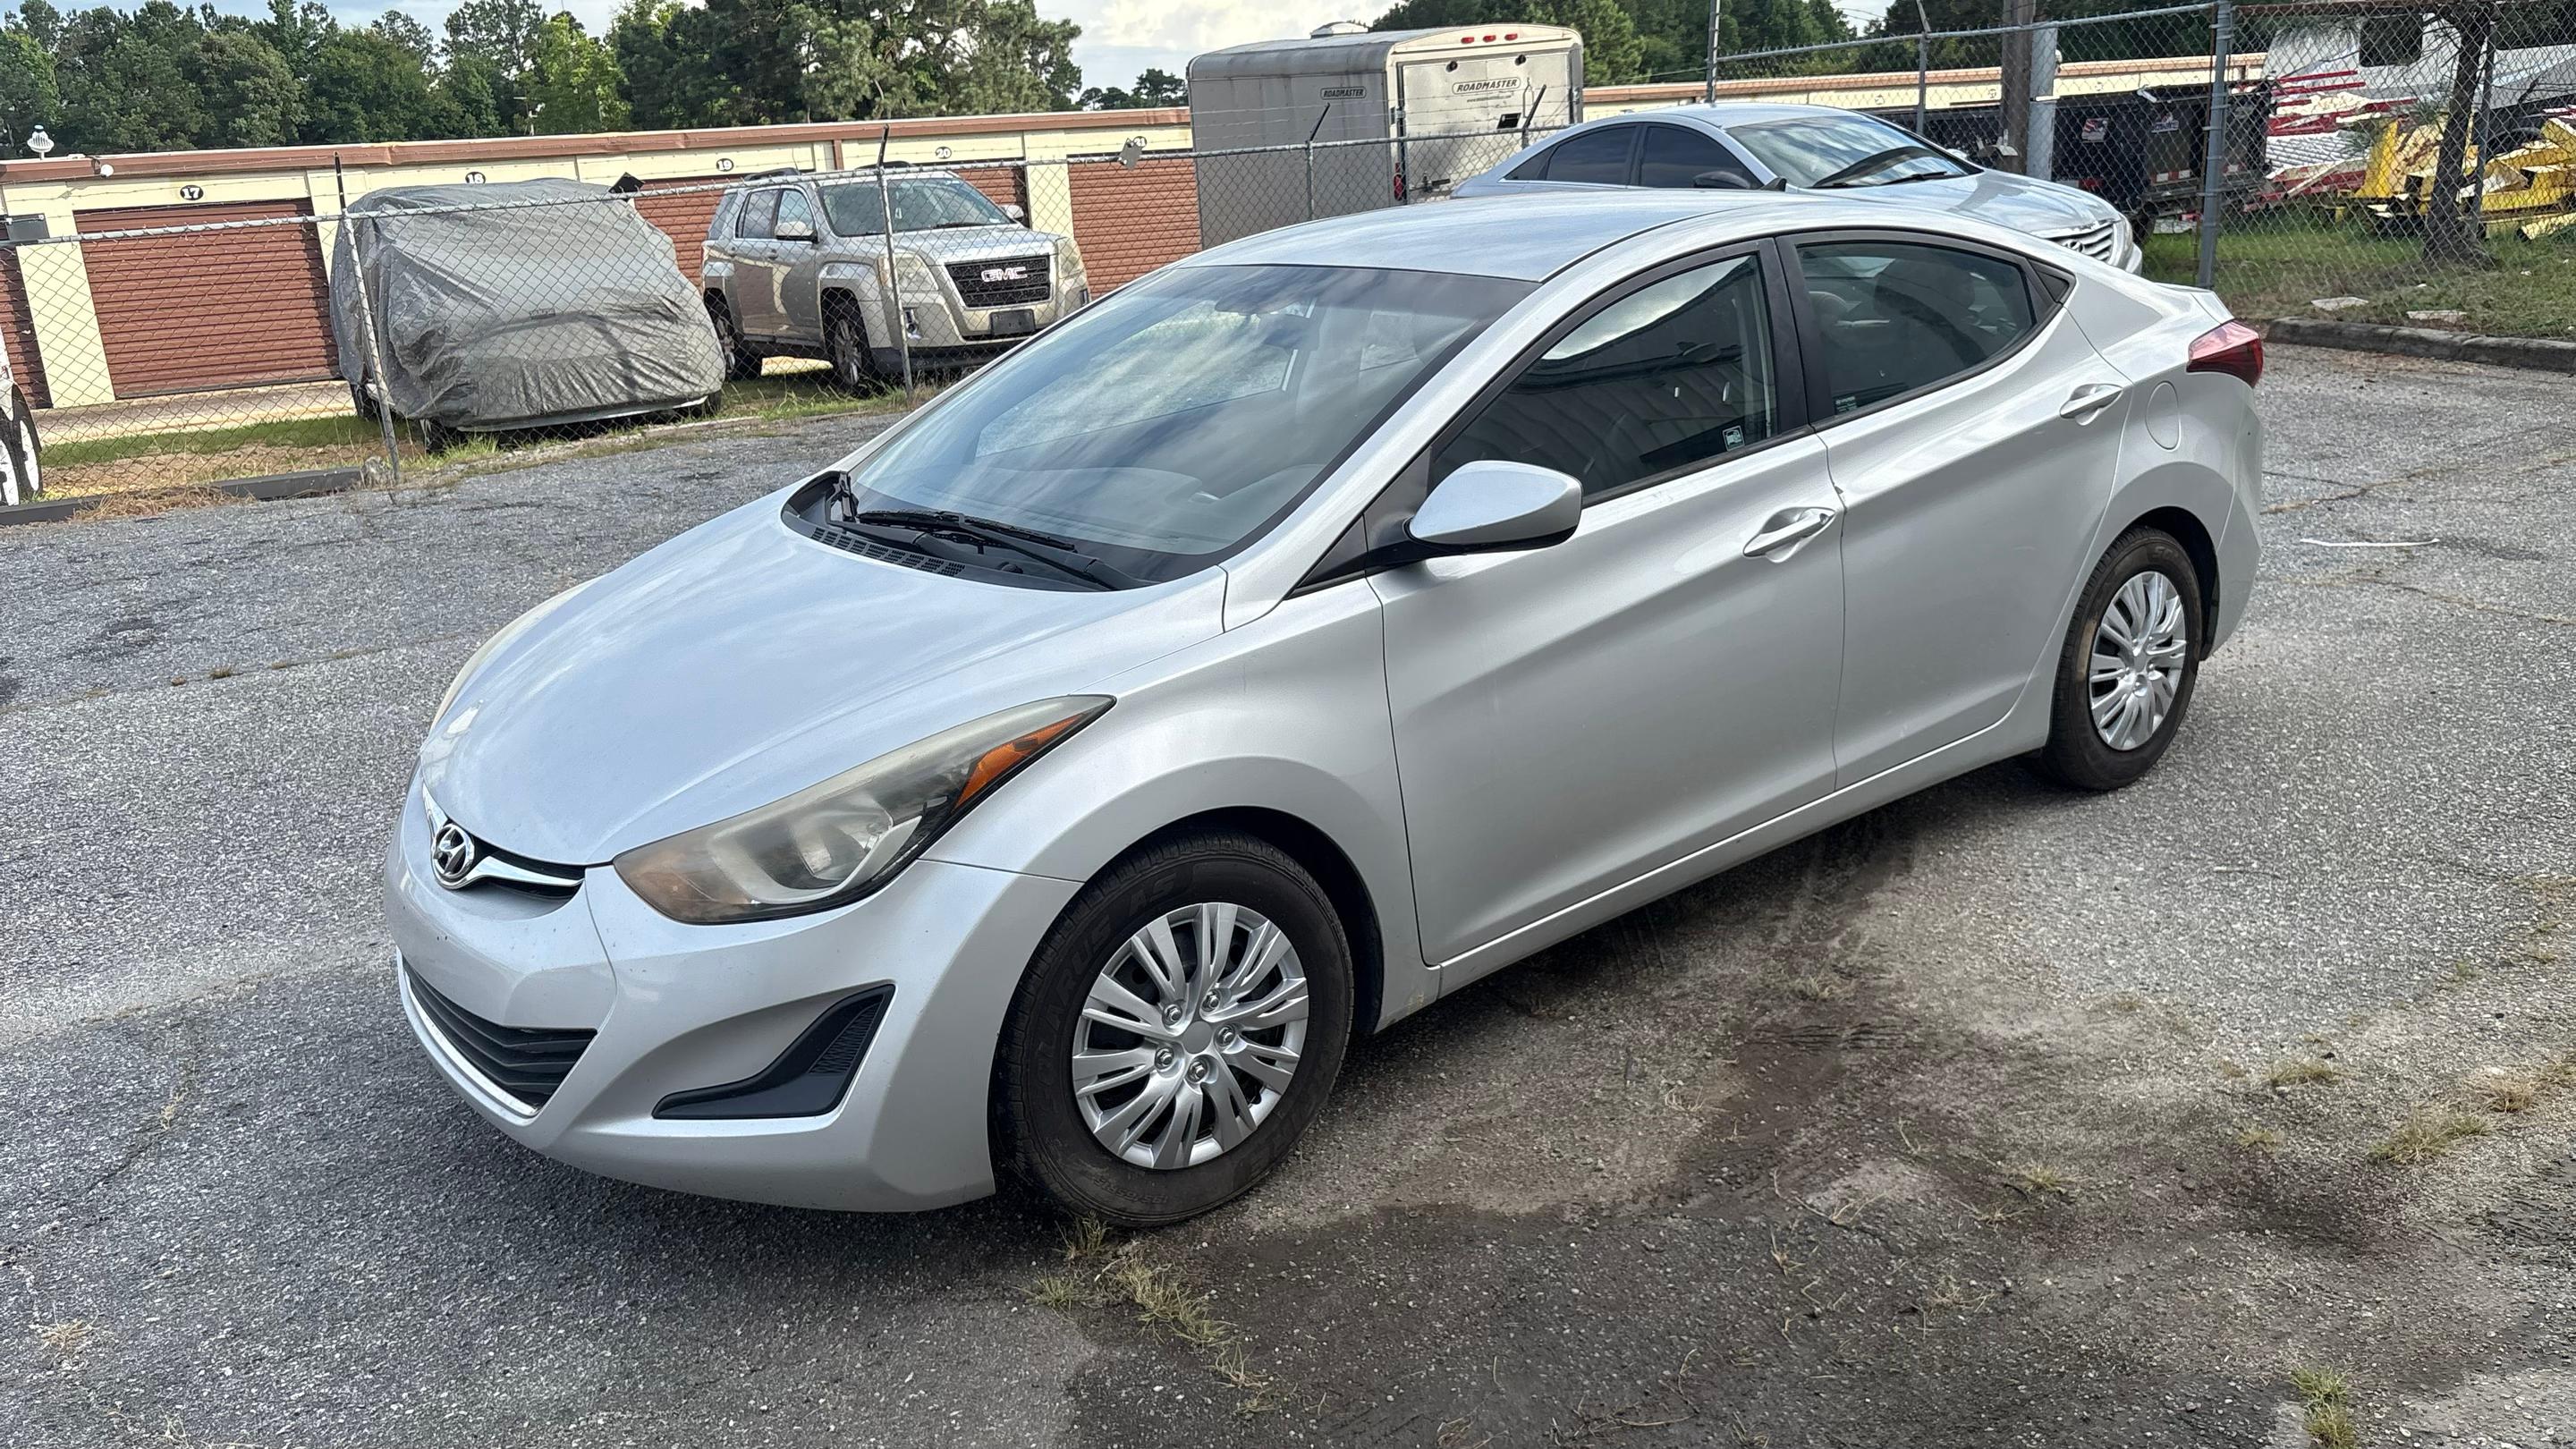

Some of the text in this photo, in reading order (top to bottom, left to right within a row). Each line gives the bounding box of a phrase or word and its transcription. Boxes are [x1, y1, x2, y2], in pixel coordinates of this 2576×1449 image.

[1457, 80, 1517, 92] ROADMASTER
[1323, 89, 1364, 98] ROADMASTER
[936, 148, 951, 158] 20
[717, 160, 732, 171] 19
[182, 187, 200, 199] 17
[981, 267, 1028, 282] GMC
